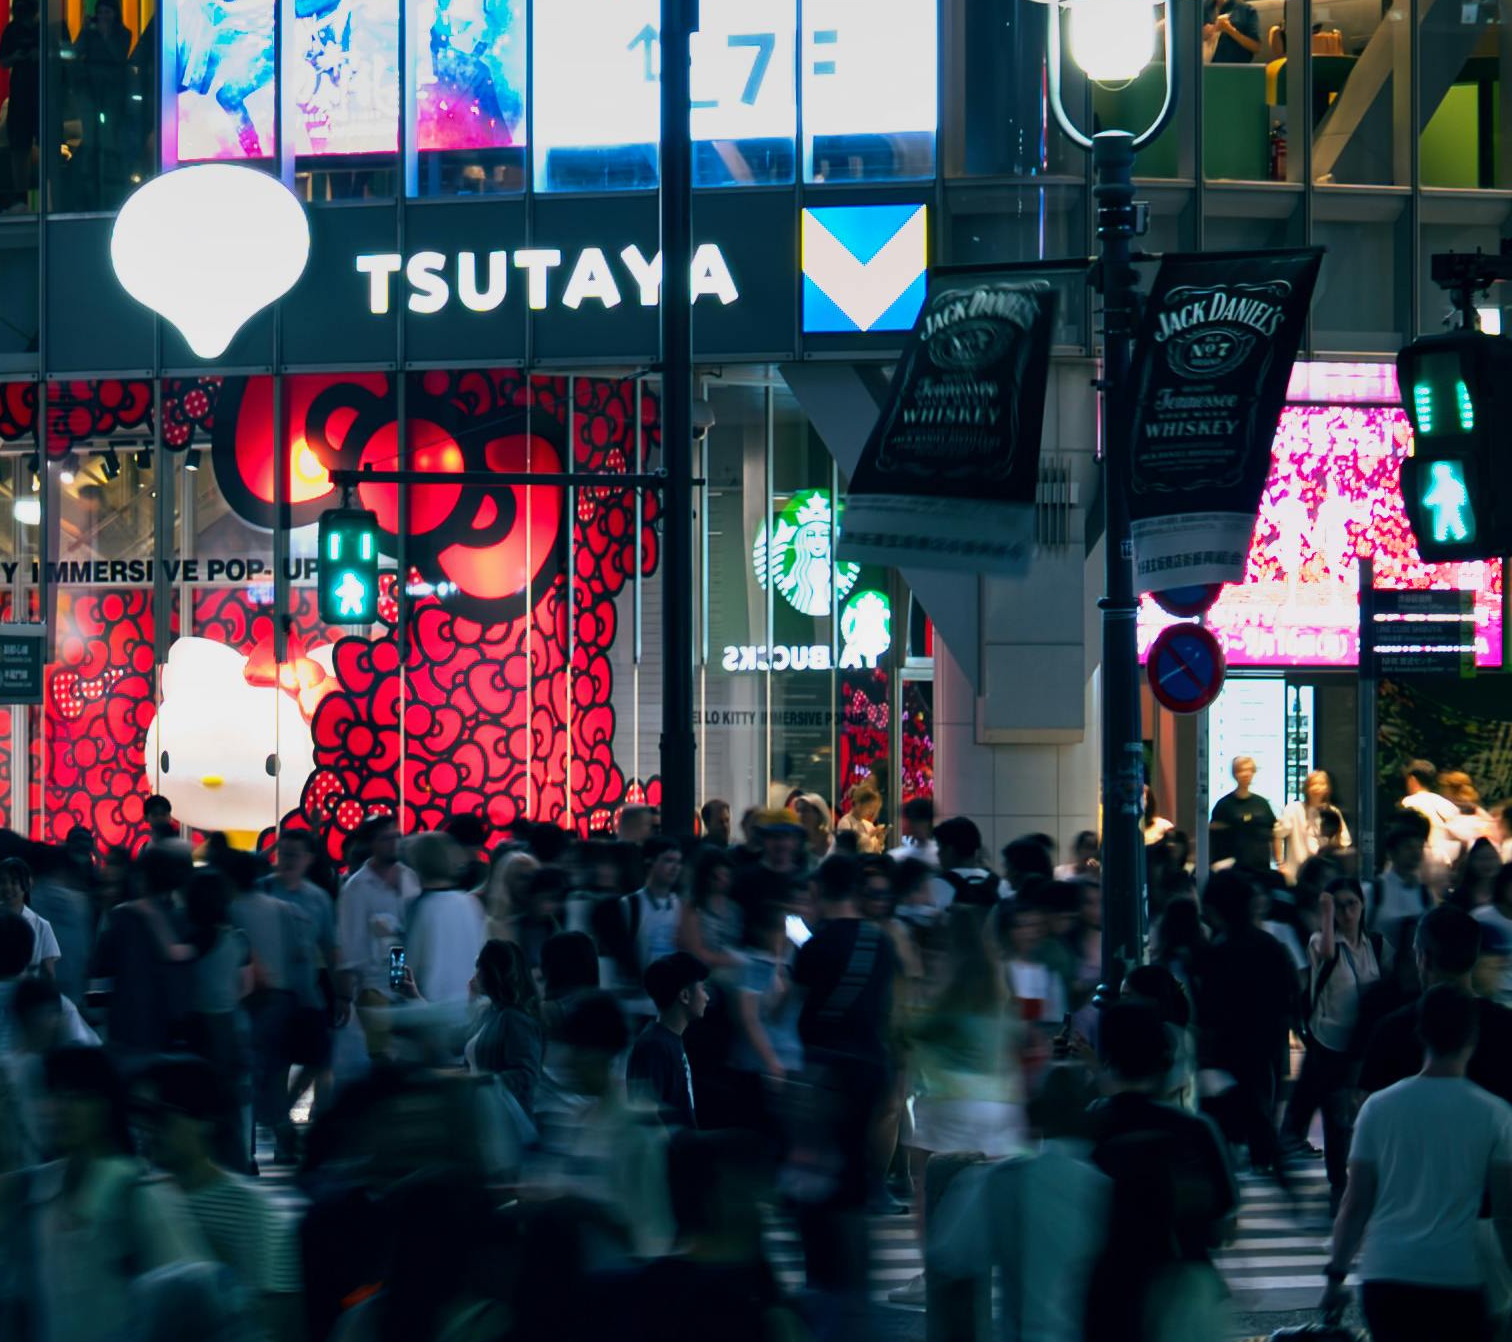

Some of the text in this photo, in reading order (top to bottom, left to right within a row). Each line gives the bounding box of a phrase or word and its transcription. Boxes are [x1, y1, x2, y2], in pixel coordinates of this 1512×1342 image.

[356, 243, 738, 315] TSUTAYA
[1154, 291, 1286, 343] JACK DANIEL'S
[903, 407, 1001, 427] WHISKEY
[1145, 420, 1240, 439] WHISKEY
[32, 558, 199, 584] IMMERSIVE
[206, 557, 318, 582] POP-UP
[691, 711, 719, 726] ELLO
